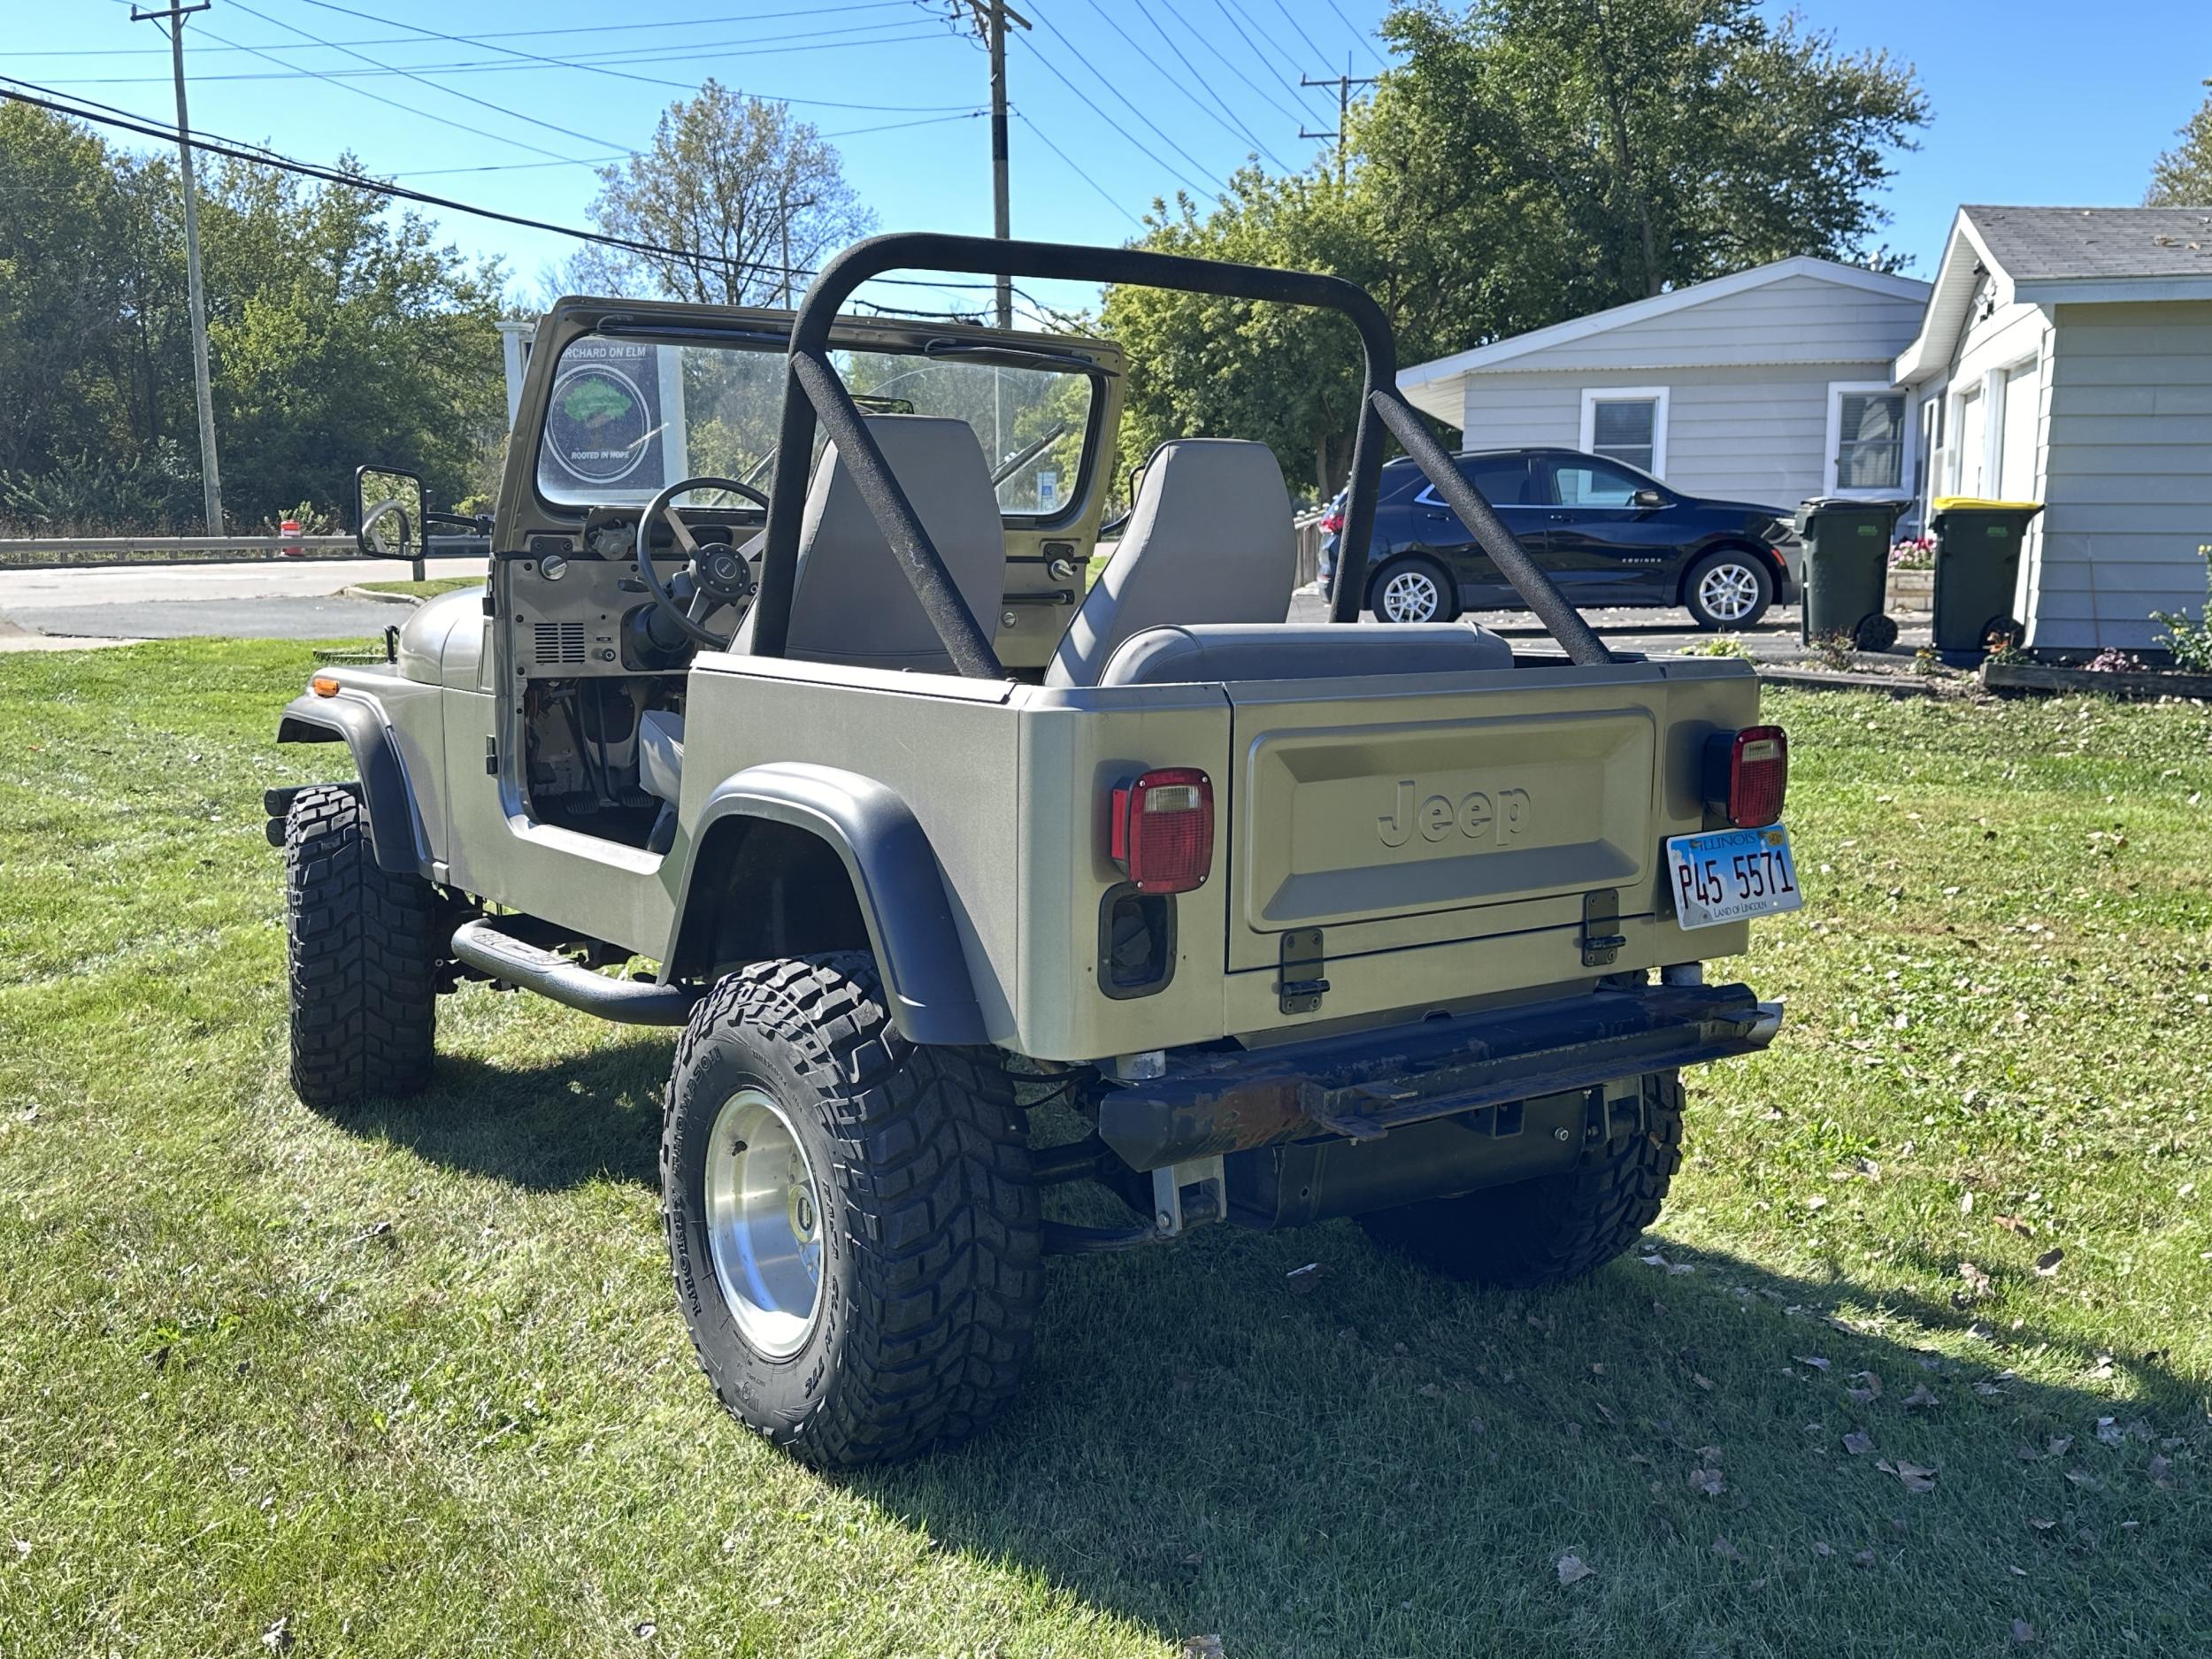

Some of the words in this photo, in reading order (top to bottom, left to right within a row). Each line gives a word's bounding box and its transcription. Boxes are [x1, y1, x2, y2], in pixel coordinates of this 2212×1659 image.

[609, 347, 624, 357] ON
[626, 346, 646, 357] ELM
[571, 451, 600, 460] ROOTED
[610, 450, 630, 459] HOPE
[1378, 780, 1532, 848] Jeep
[1700, 832, 1756, 851] ILLINOIS
[1678, 859, 1723, 910] P45
[1732, 849, 1794, 900] 5571
[672, 1045, 723, 1175] THOMPSON
